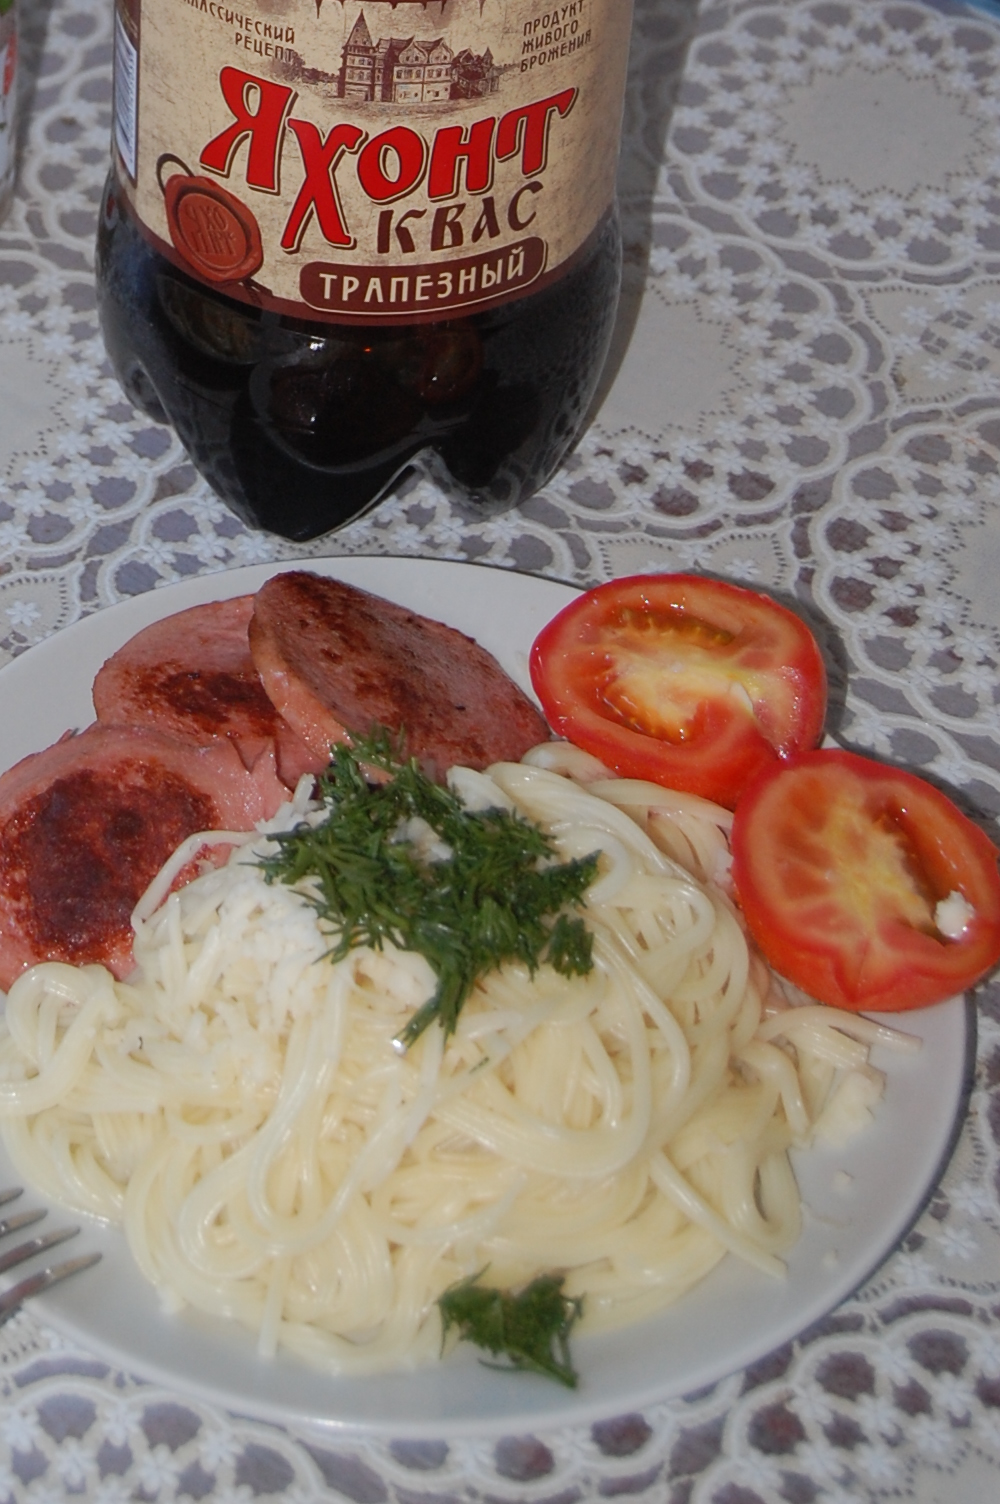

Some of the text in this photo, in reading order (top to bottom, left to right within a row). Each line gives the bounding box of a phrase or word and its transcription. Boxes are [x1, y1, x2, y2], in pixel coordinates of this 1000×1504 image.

[235, 32, 294, 62] РЕЦЕПТ
[520, 29, 592, 73] БРОЖЕНИЯ
[521, 20, 579, 54] ЖИВОГО
[200, 65, 579, 254] ЯХОНТ
[377, 180, 545, 254] КВАС
[318, 247, 526, 304] ТРАПЕЗНЫЙ
